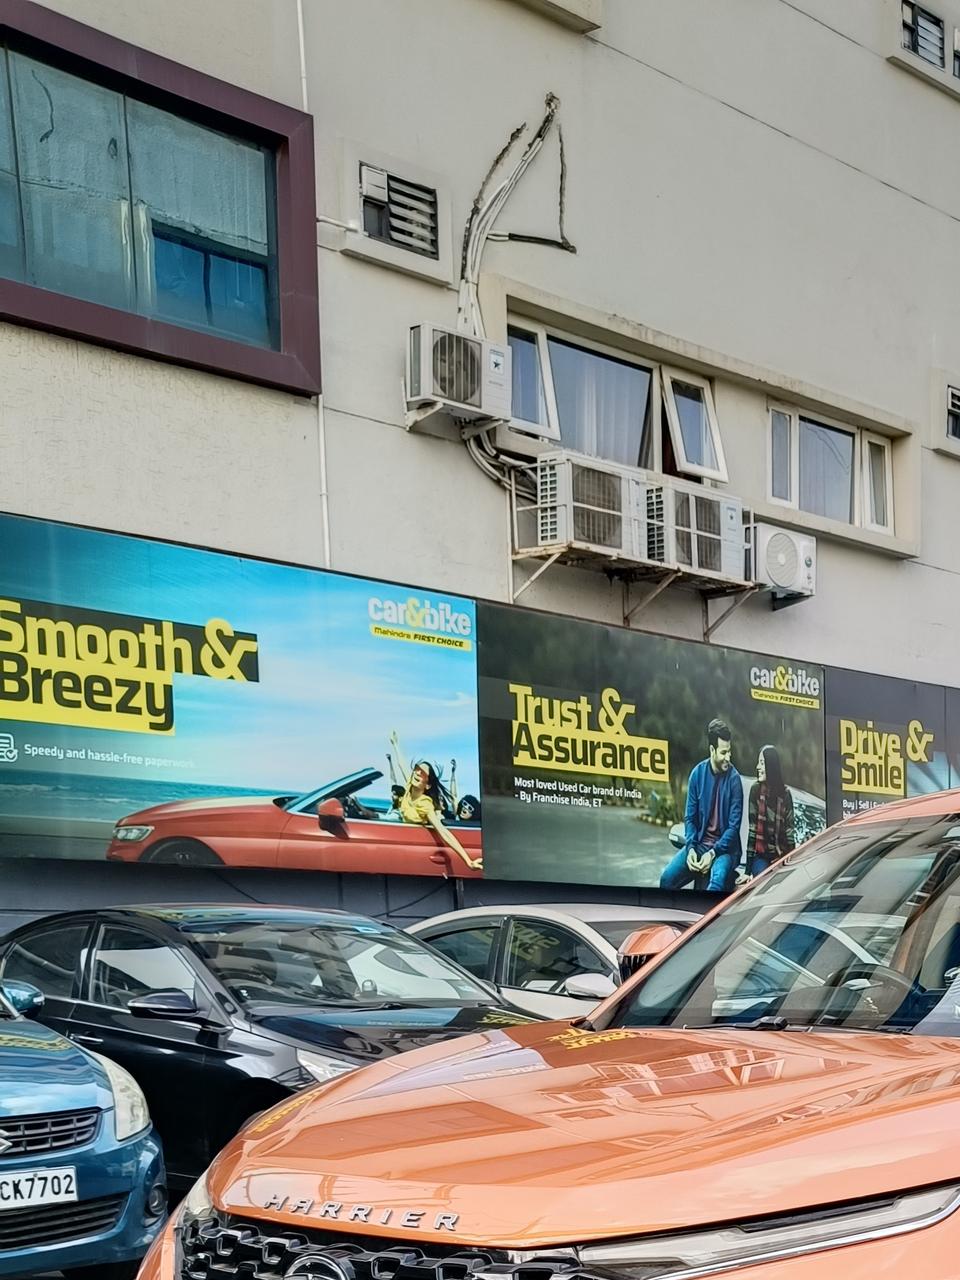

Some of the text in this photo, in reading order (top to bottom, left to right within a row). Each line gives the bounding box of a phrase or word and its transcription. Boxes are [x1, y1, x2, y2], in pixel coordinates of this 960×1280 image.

[368, 597, 472, 635] car&bike
[0, 600, 258, 683] Smooth &
[413, 633, 436, 643] FIRST
[436, 637, 464, 648] CHOICE
[0, 652, 174, 732] Breezy
[750, 665, 820, 696] car&bike
[509, 683, 636, 736] Trust &
[24, 743, 64, 760] Speedy
[66, 747, 86, 759] and
[88, 748, 142, 765] hassle-free
[513, 722, 666, 775] Assurance
[840, 719, 934, 762] Drive &
[514, 776, 642, 799] Most loved Used Car brand of India
[842, 752, 902, 789] Smile
[519, 791, 532, 803] By
[532, 792, 570, 805] Franchise
[571, 795, 592, 808] India,
[593, 798, 603, 808] ET
[842, 799, 855, 811] Buy
[0, 1174, 75, 1201] CK7702
[263, 1194, 460, 1231] HARRIER
